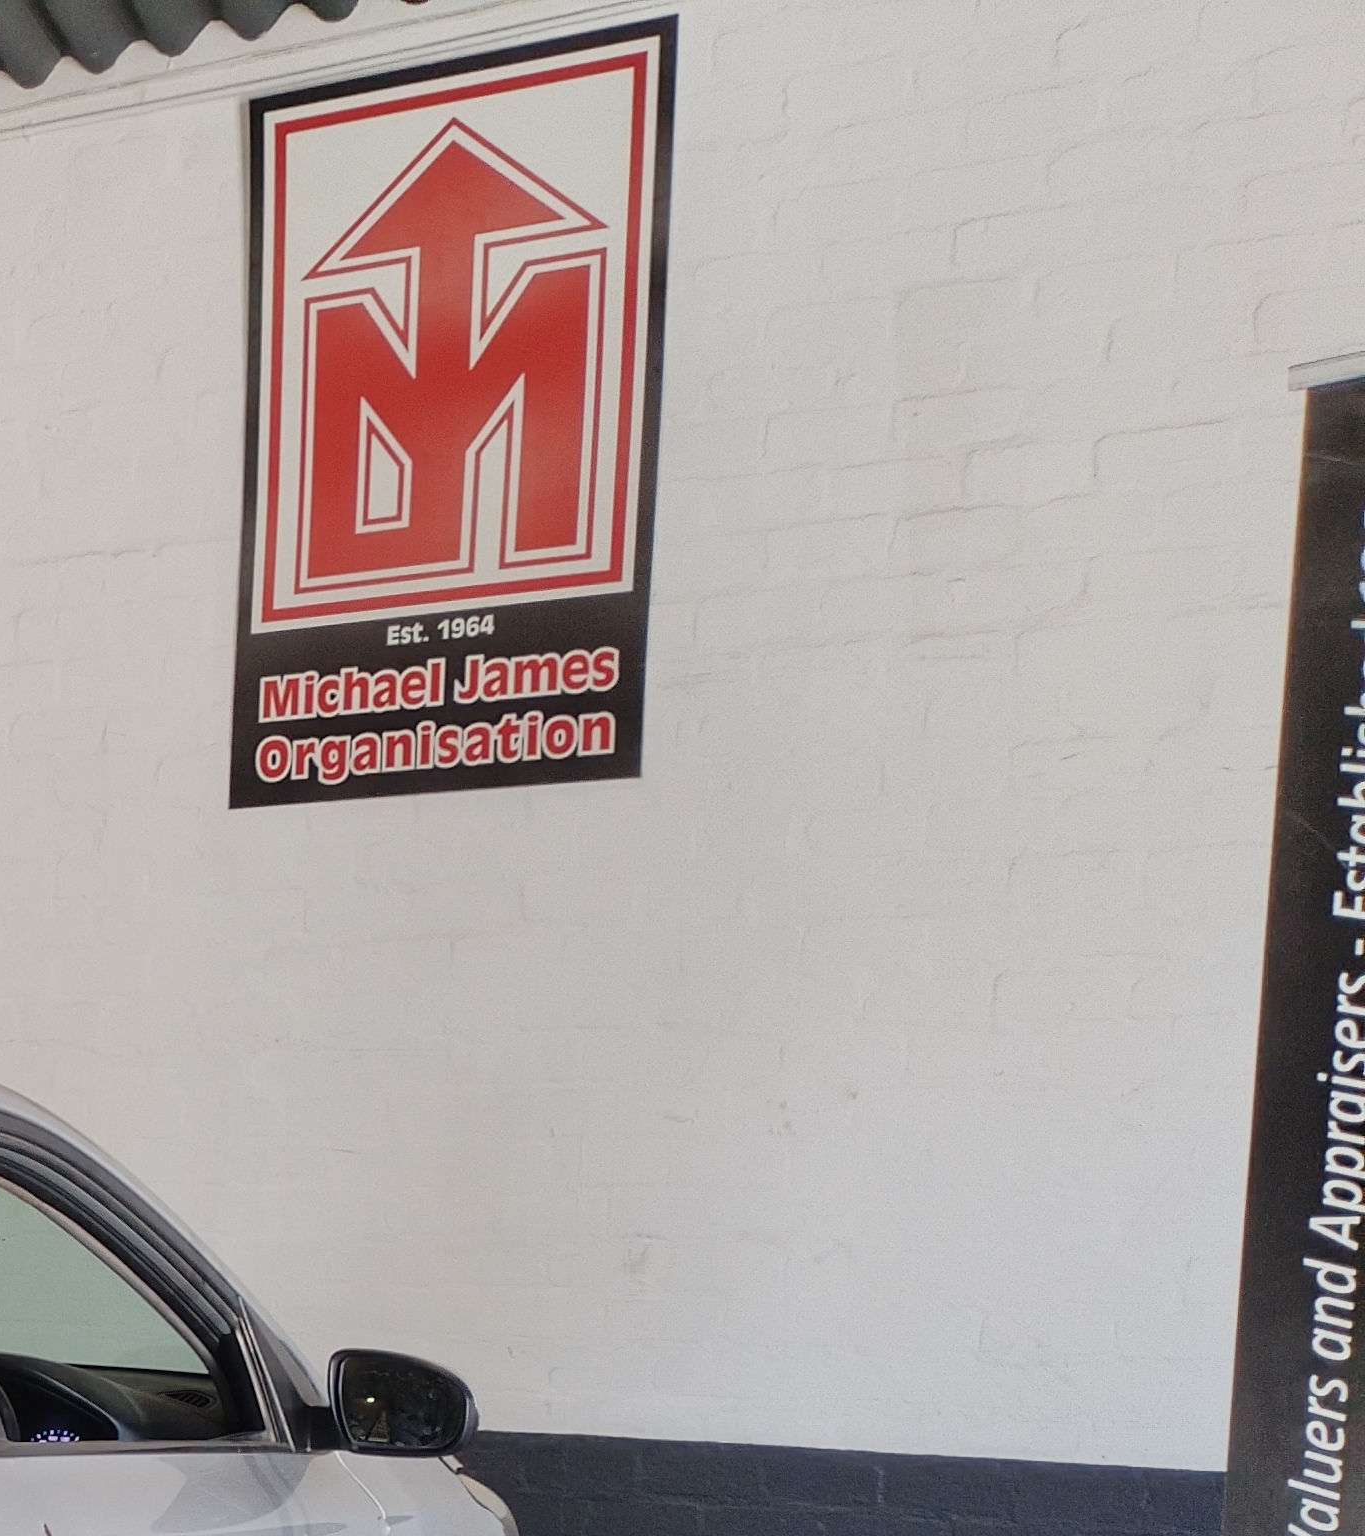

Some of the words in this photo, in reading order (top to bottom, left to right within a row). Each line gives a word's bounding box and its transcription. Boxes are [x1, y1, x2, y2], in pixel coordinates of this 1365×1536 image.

[385, 623, 430, 646] Est.
[437, 614, 495, 640] 1964
[258, 657, 446, 724] Michael
[453, 646, 620, 703] James
[255, 710, 616, 786] Organisation
[1302, 1257, 1357, 1362] and
